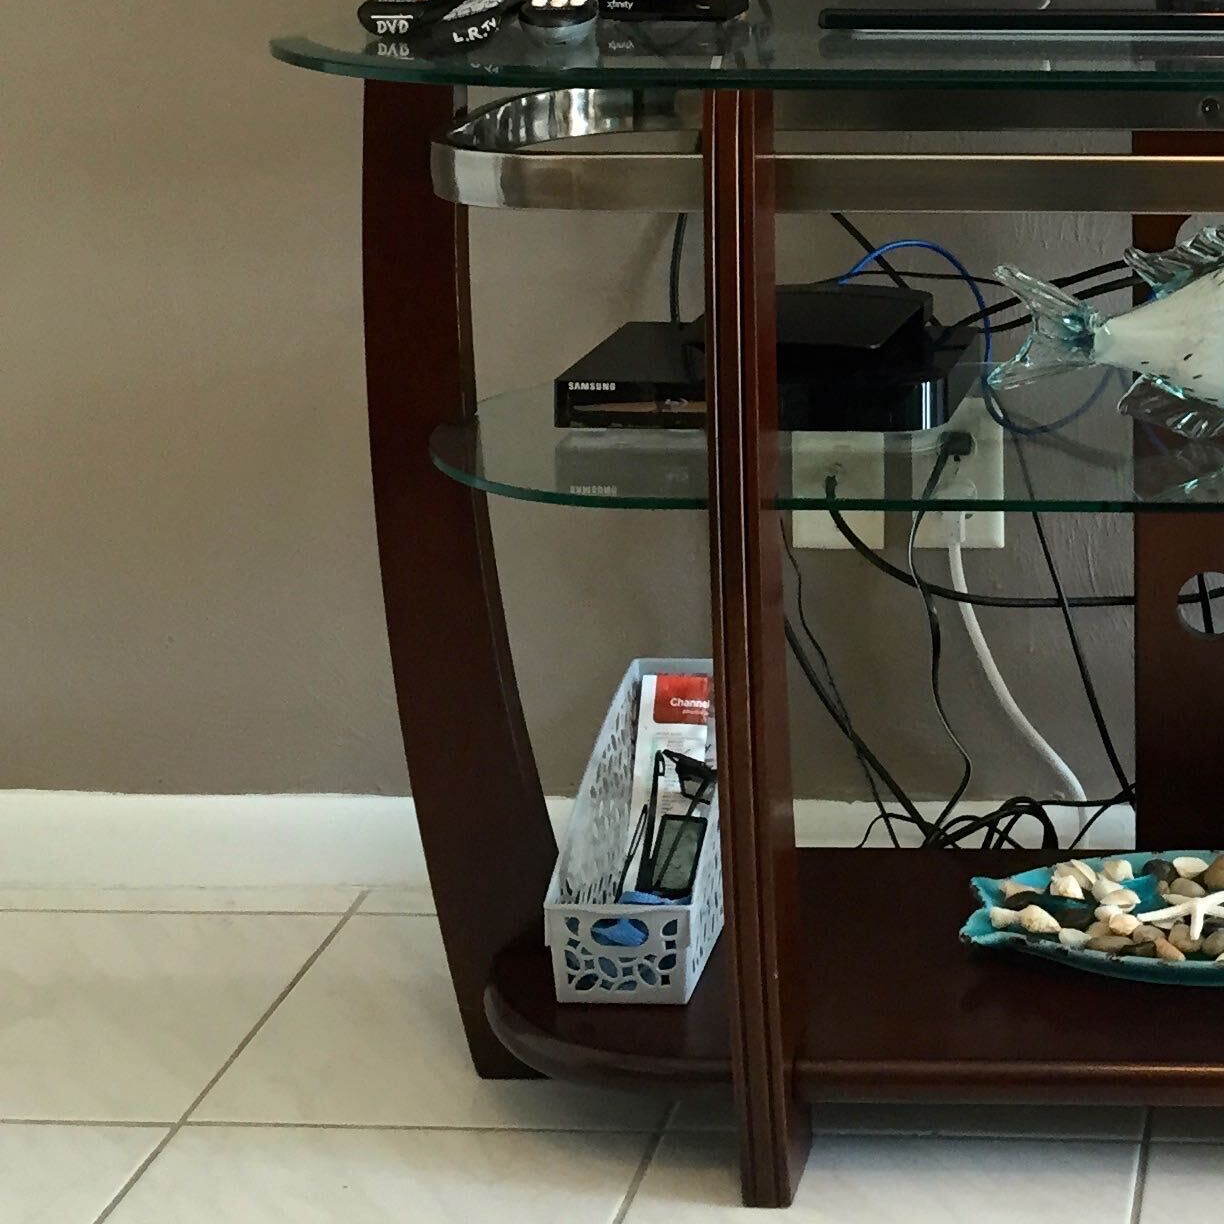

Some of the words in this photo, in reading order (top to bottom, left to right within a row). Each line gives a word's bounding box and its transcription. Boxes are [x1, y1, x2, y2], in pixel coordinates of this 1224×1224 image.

[376, 19, 409, 34] DVD
[568, 381, 616, 391] SAMSUNG
[669, 697, 711, 709] Channel
